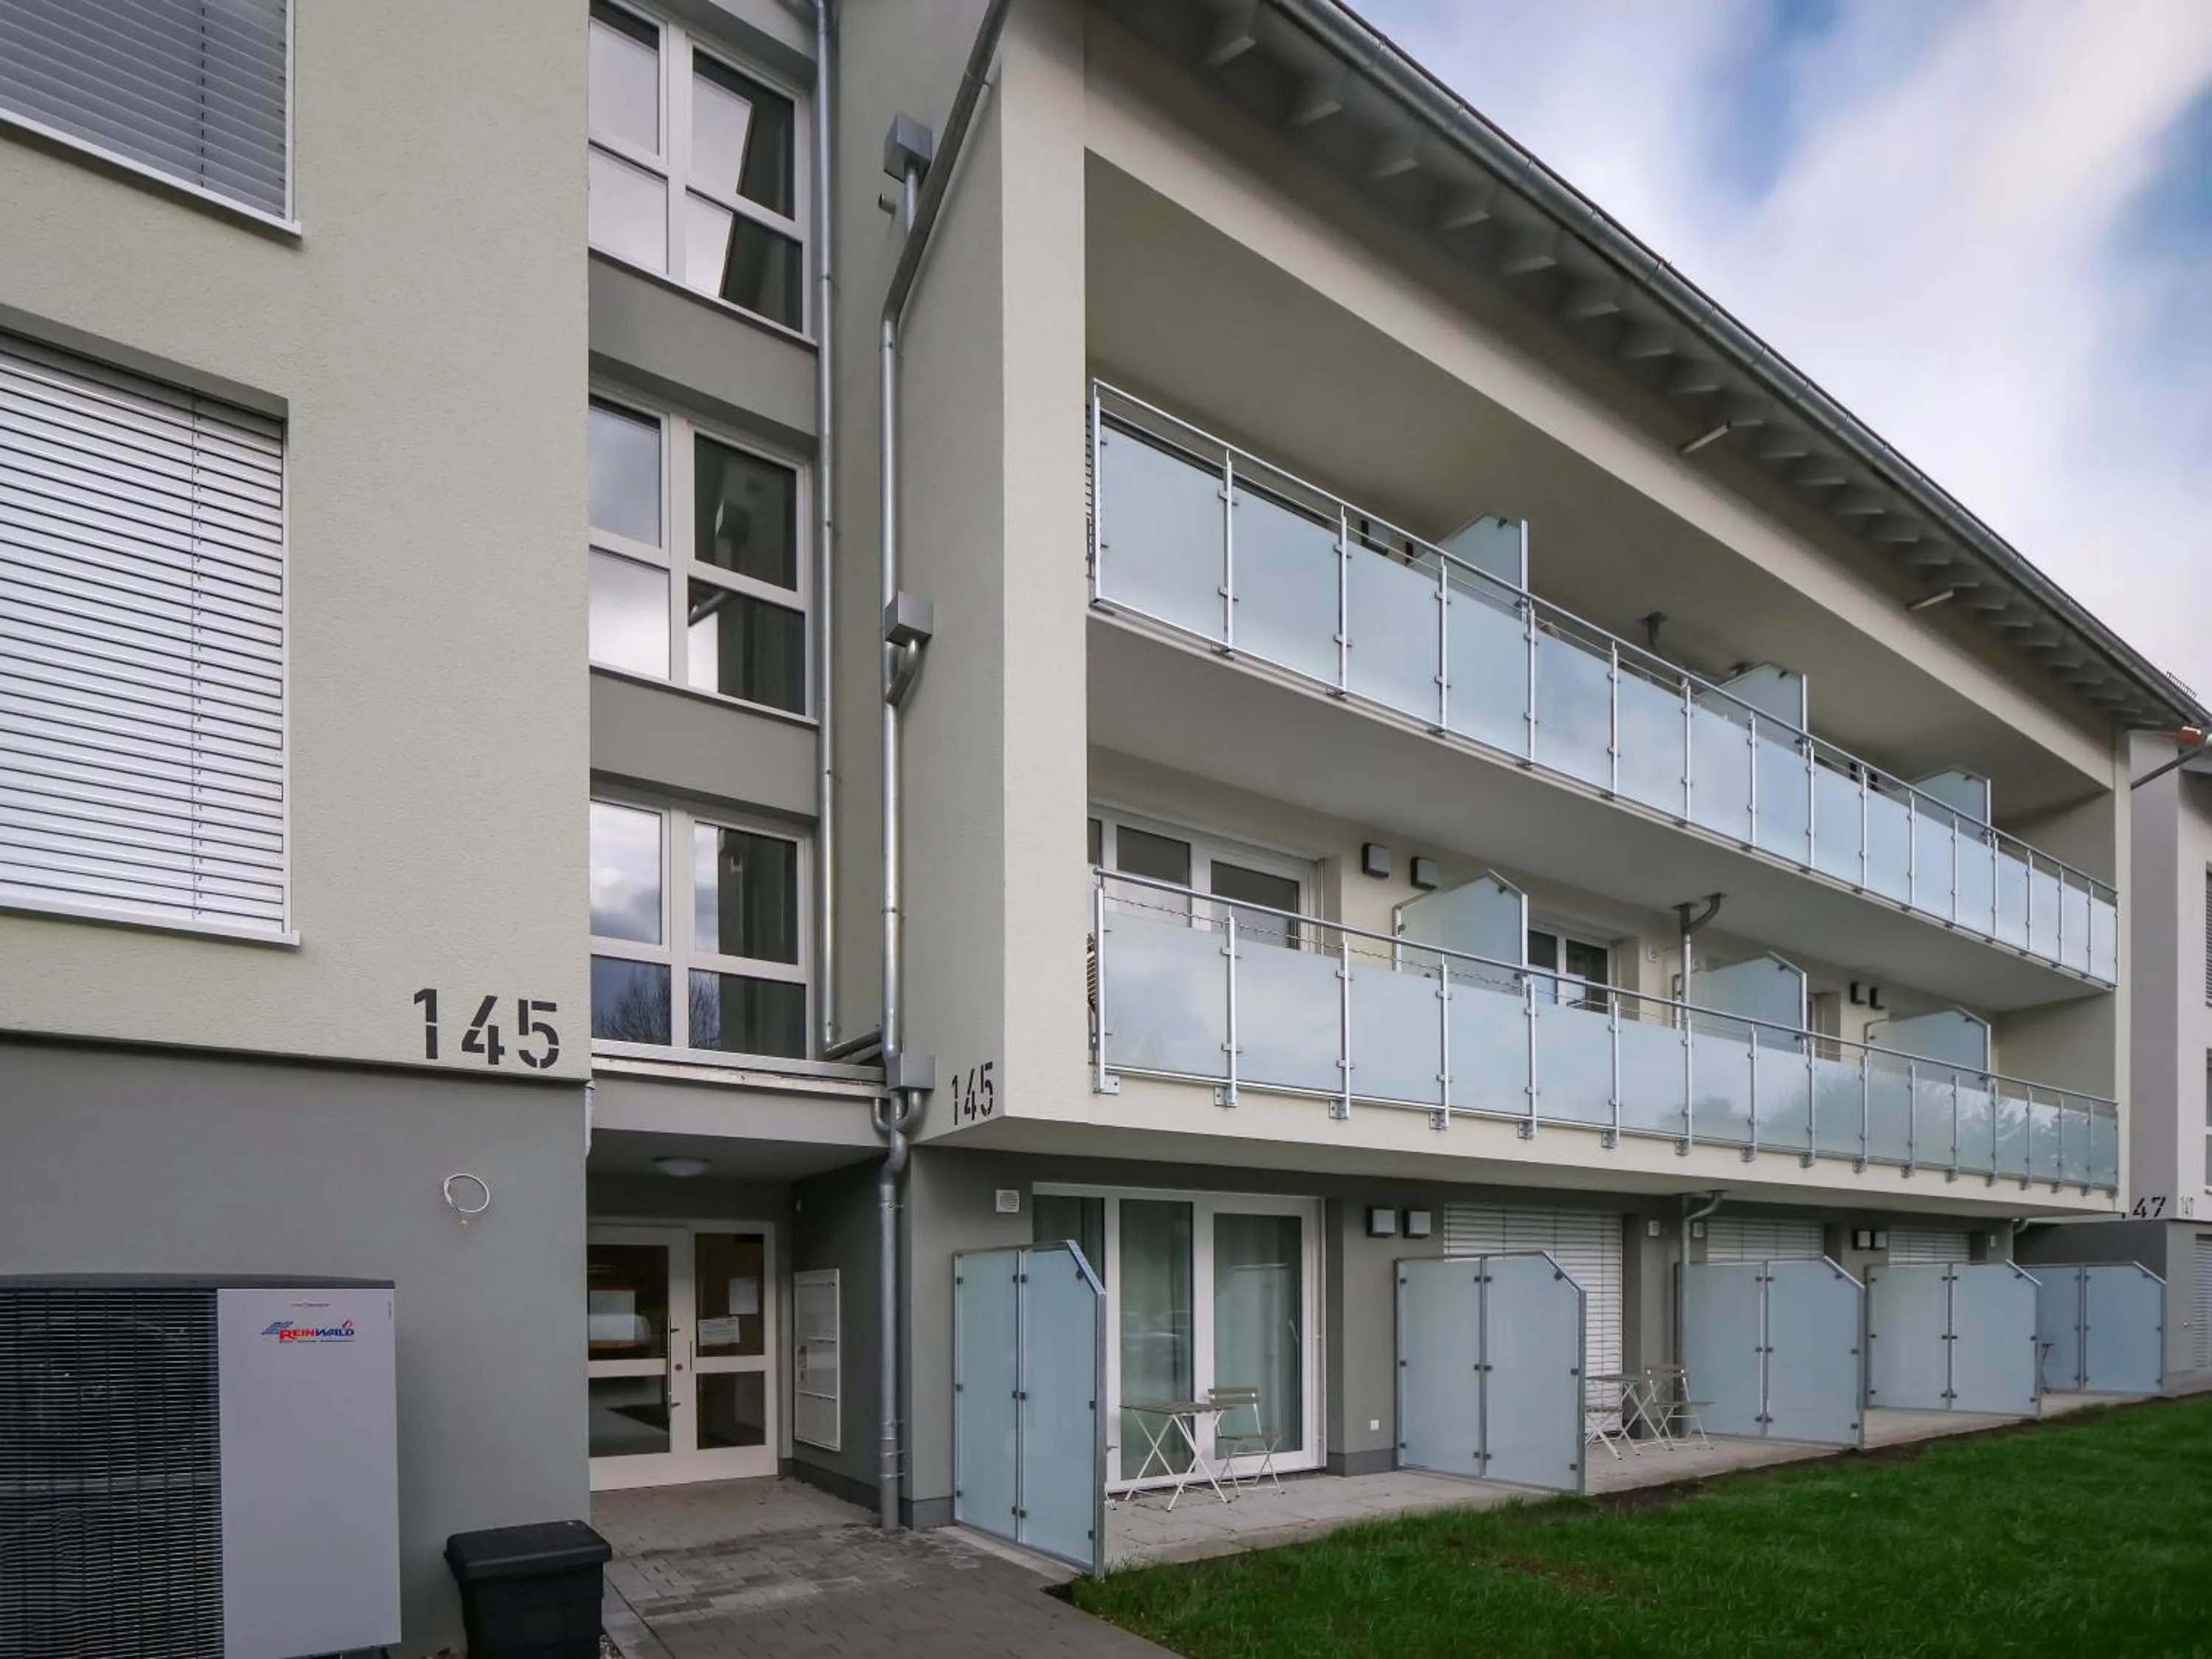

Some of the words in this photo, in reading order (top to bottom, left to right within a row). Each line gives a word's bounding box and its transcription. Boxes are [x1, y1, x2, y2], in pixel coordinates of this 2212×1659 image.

[414, 988, 559, 1068] 145
[952, 1062, 993, 1125] 145
[279, 1329, 354, 1340] REINWALD
